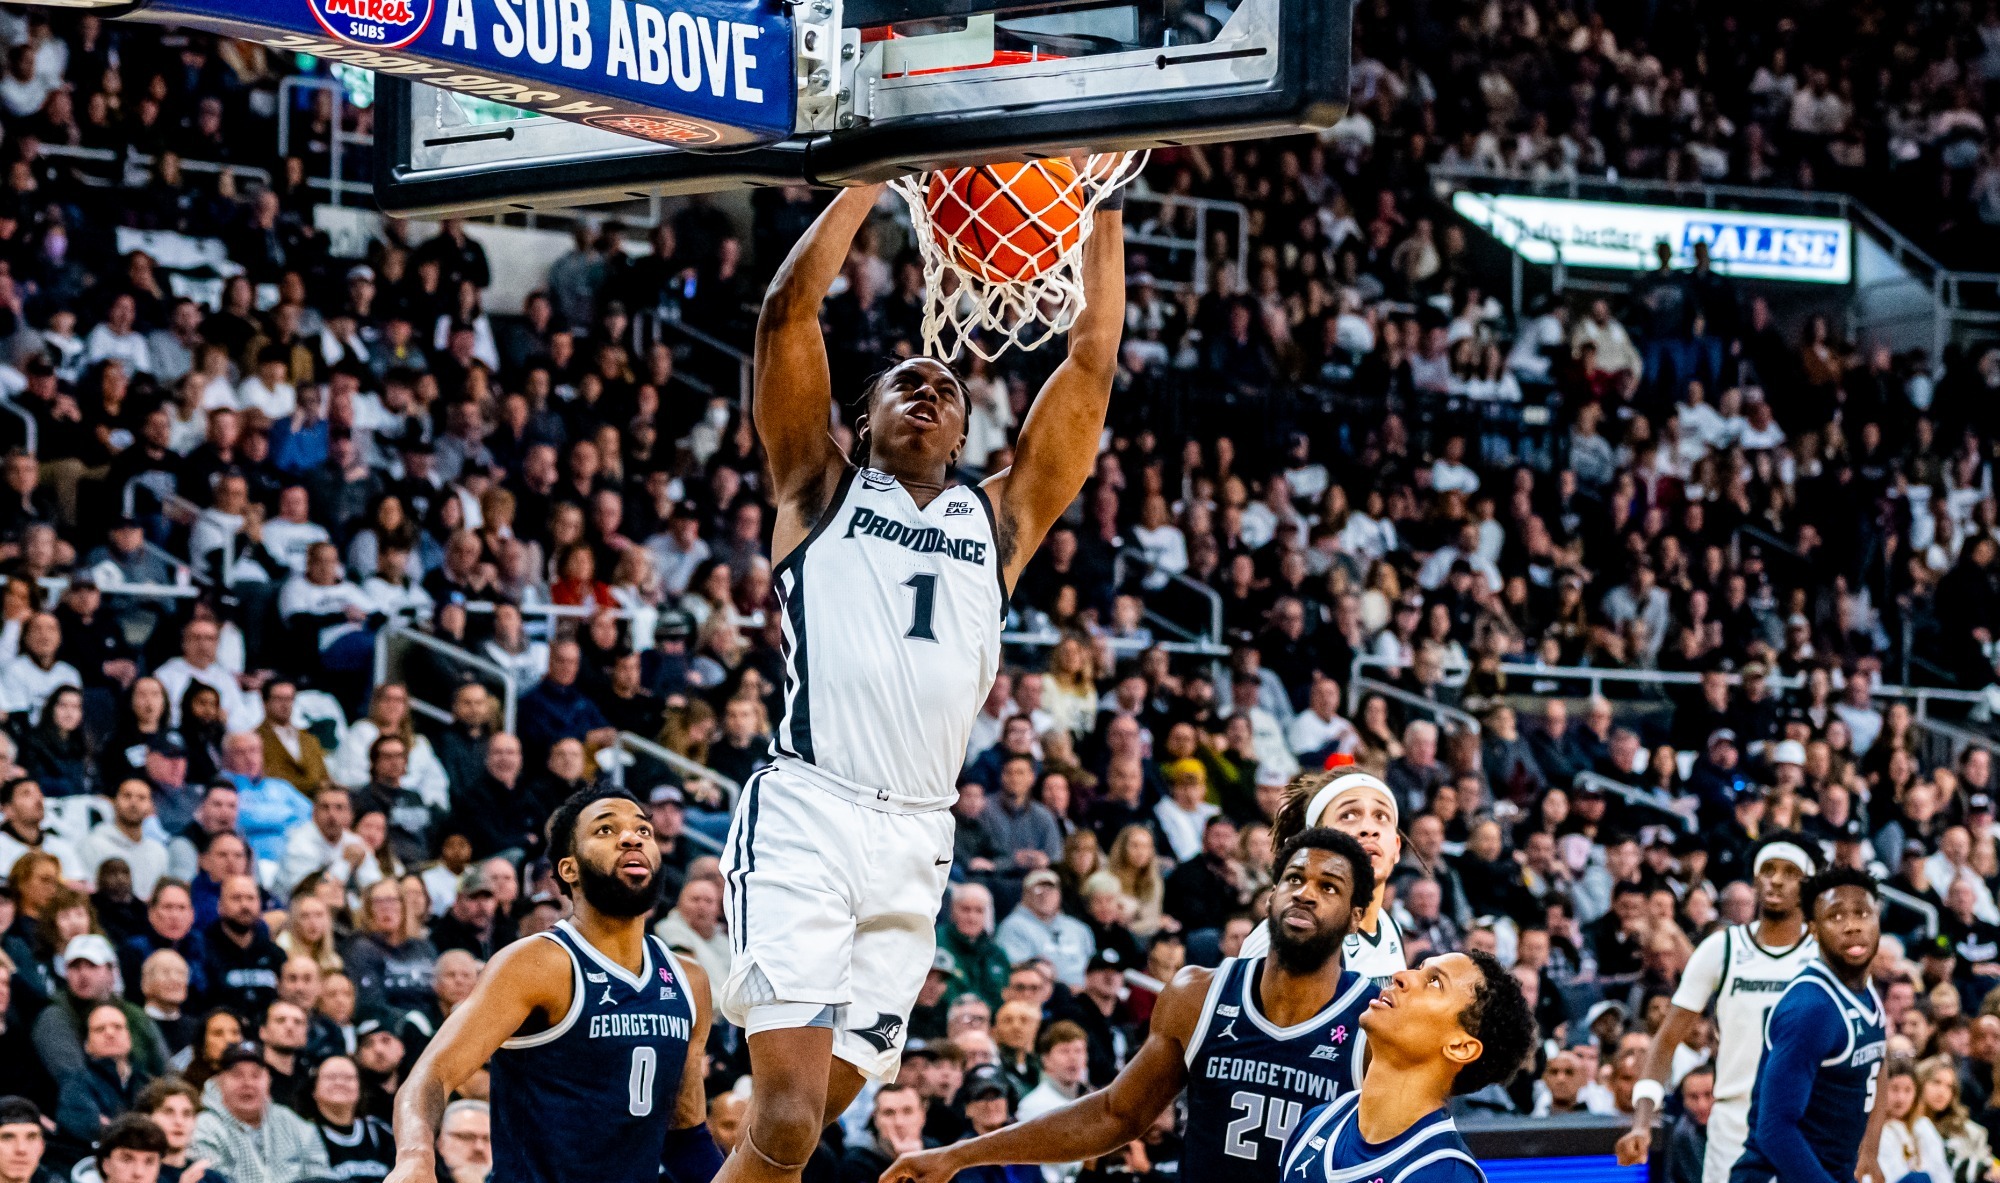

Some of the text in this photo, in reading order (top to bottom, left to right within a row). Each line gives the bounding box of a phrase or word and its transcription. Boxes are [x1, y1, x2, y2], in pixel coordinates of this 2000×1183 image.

[263, 35, 455, 74] ABOVE
[350, 22, 386, 40] SUBS
[442, 0, 764, 104] A SUB ABOVE
[422, 74, 561, 103] SUB
[842, 506, 988, 567] PROVIDENCE
[900, 571, 940, 645] 1
[589, 1013, 690, 1042] GEORGETOWN
[629, 1046, 657, 1117] 0
[1206, 1056, 1339, 1102] GEORGETOWN
[1224, 1090, 1303, 1167] 24
